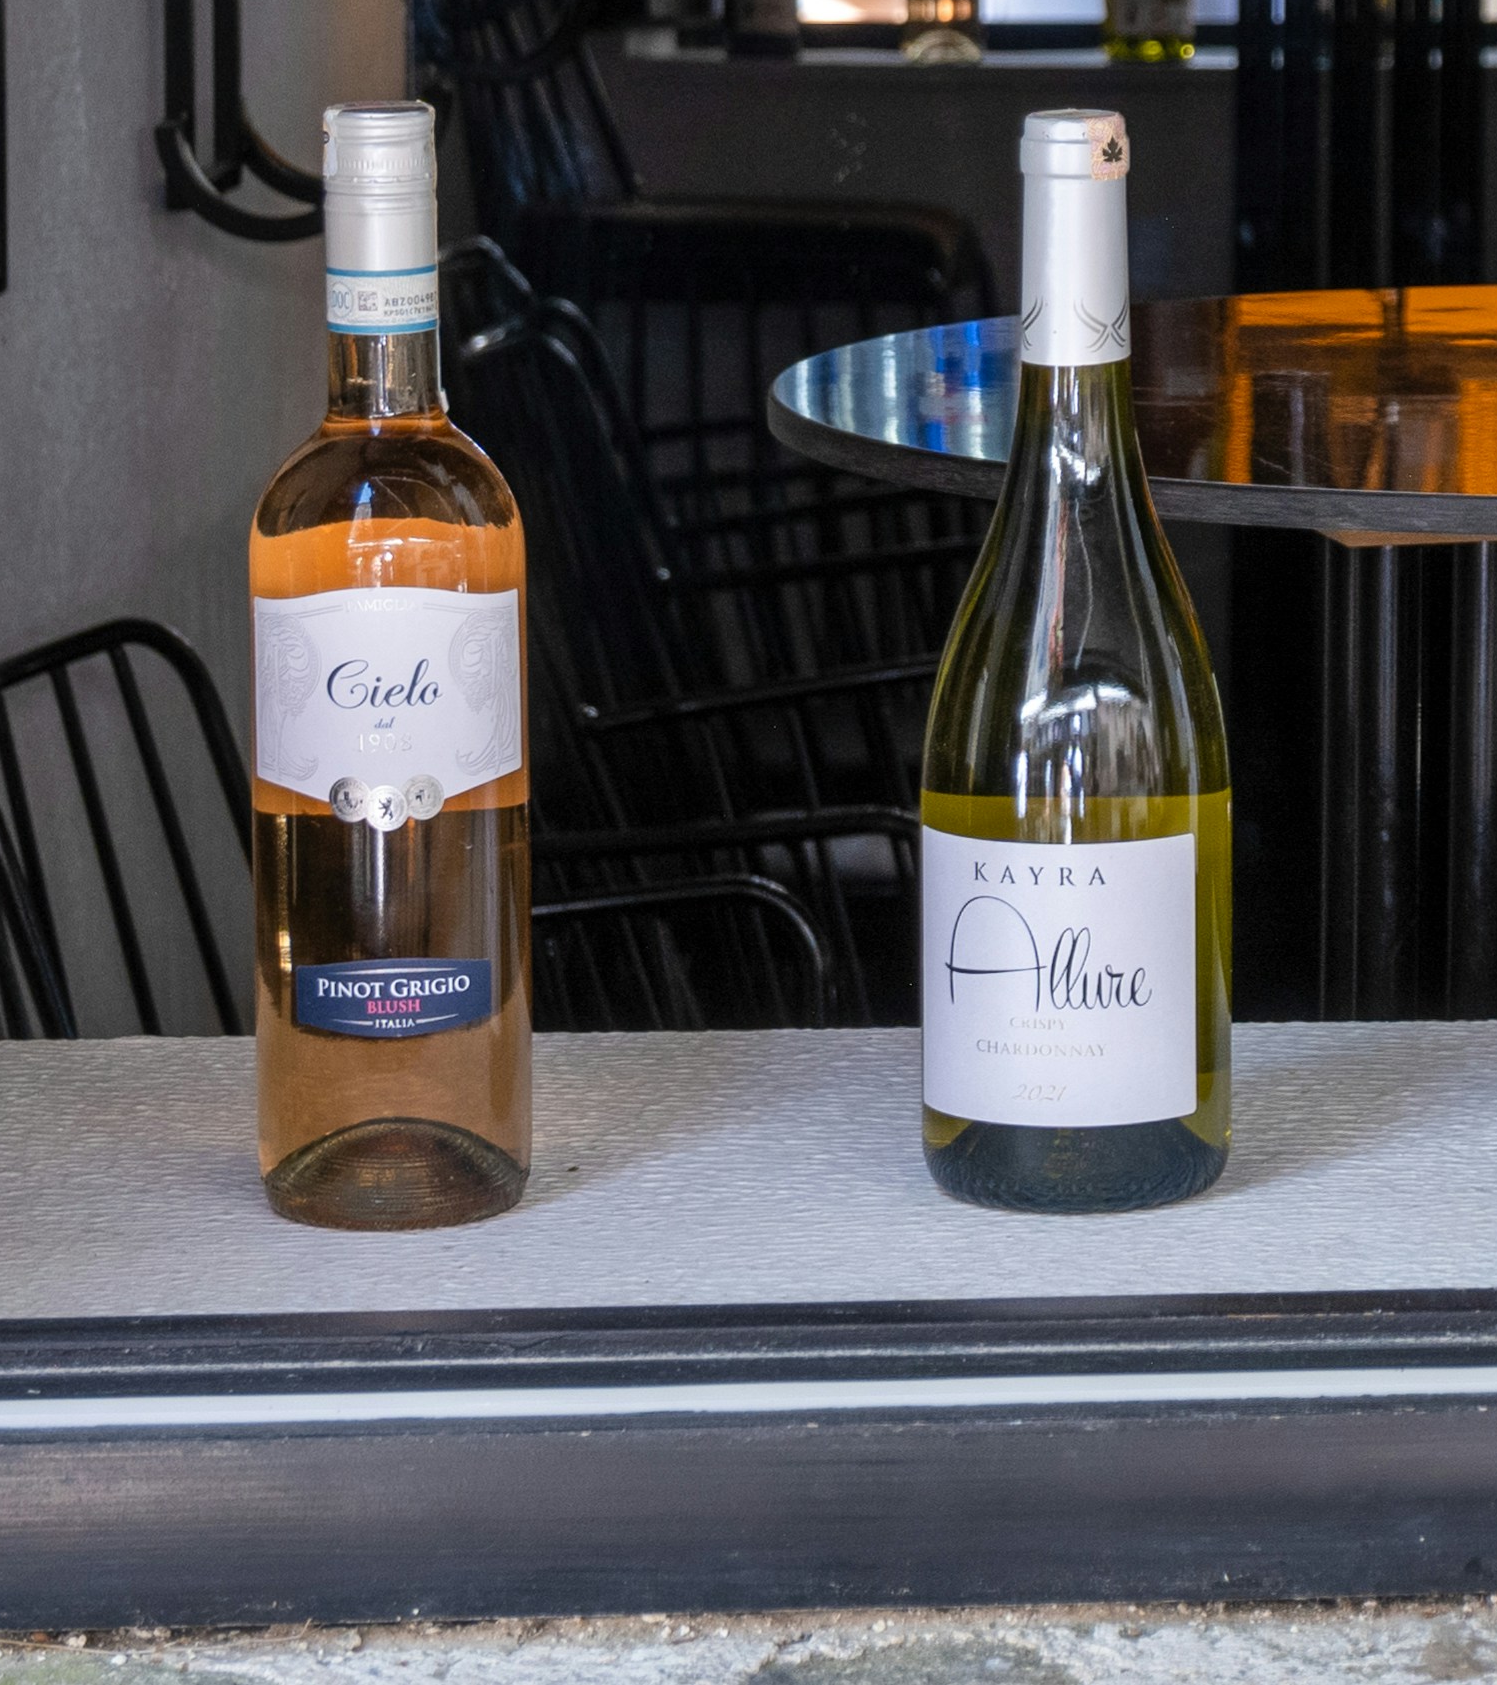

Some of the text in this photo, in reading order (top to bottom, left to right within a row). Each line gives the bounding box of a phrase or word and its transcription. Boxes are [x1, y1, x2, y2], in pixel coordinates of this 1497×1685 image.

[331, 290, 350, 310] DOC
[326, 658, 444, 710] Cielo
[374, 716, 395, 730] dal
[357, 732, 413, 754] 1908
[974, 861, 1107, 886] KAYRA
[945, 894, 1153, 1013] Allure
[316, 973, 471, 1000] PINOT GRIGIO
[366, 999, 422, 1015] BLUSH
[373, 1017, 416, 1030] ITALIA
[976, 1038, 1108, 1058] CHARDONNAY
[1011, 1083, 1068, 1102] 2021
